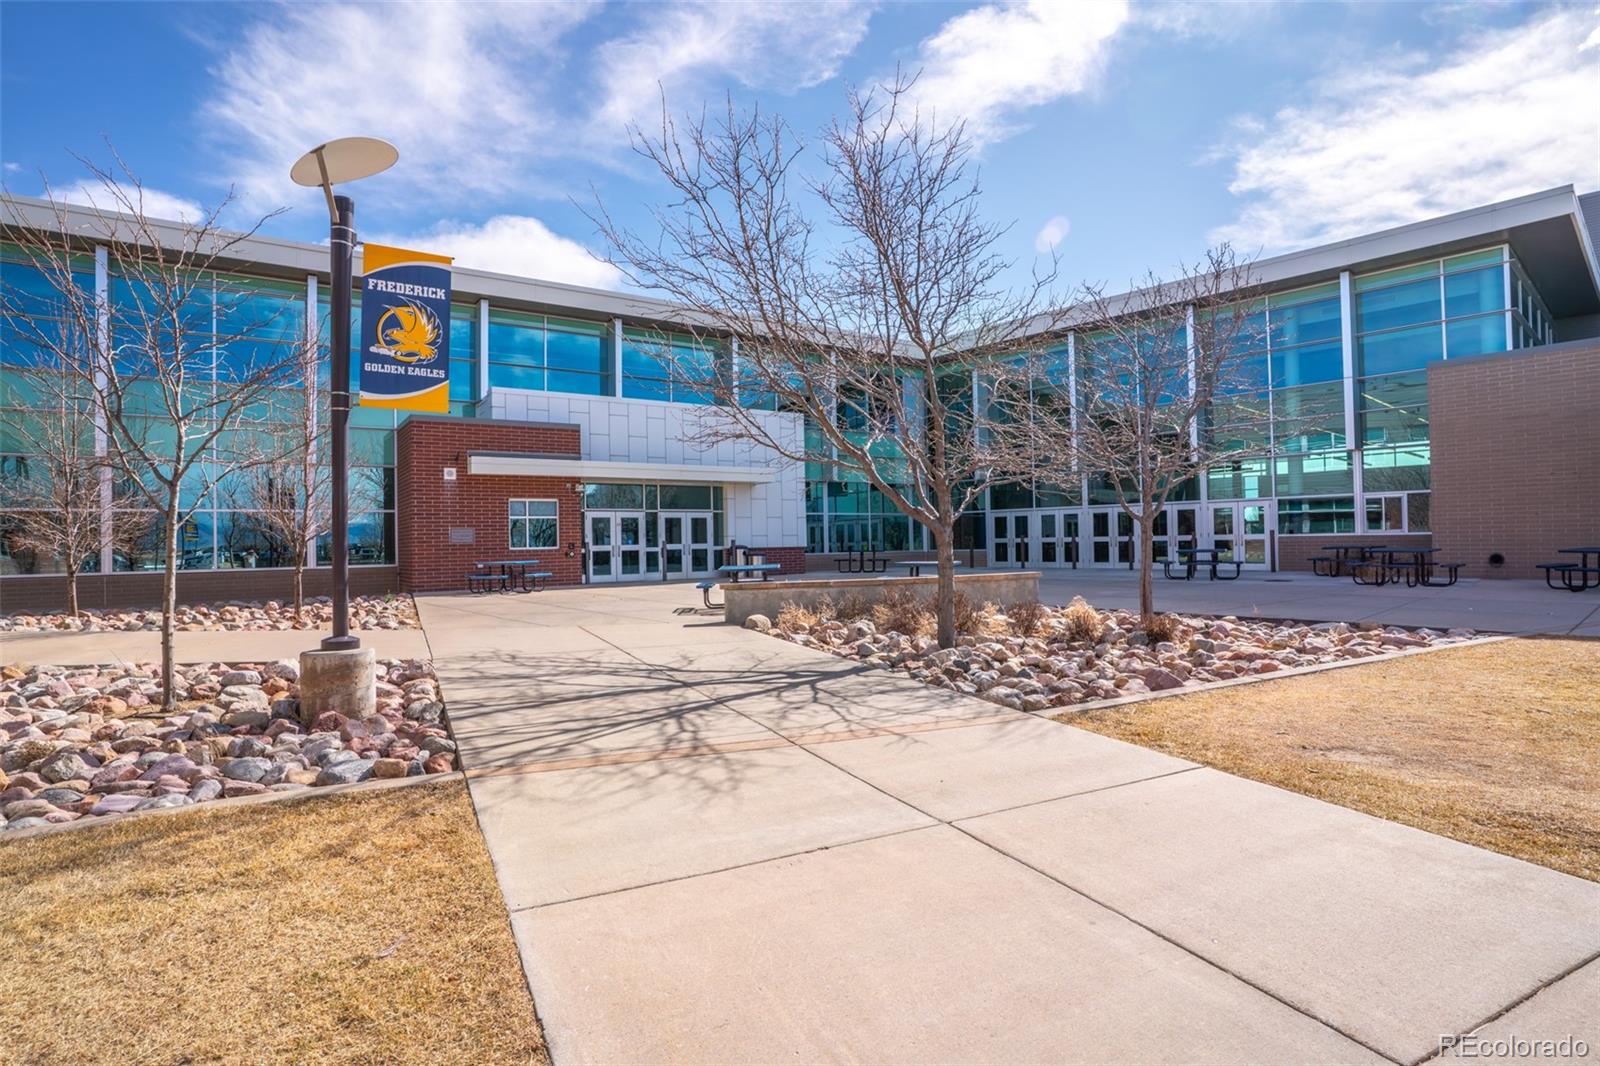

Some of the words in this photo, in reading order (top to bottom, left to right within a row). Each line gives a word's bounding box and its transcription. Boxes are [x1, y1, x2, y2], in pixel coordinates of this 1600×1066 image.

[367, 278, 446, 300] FREDERICK
[364, 362, 405, 375] GOLDEN
[407, 366, 445, 378] EAGLES
